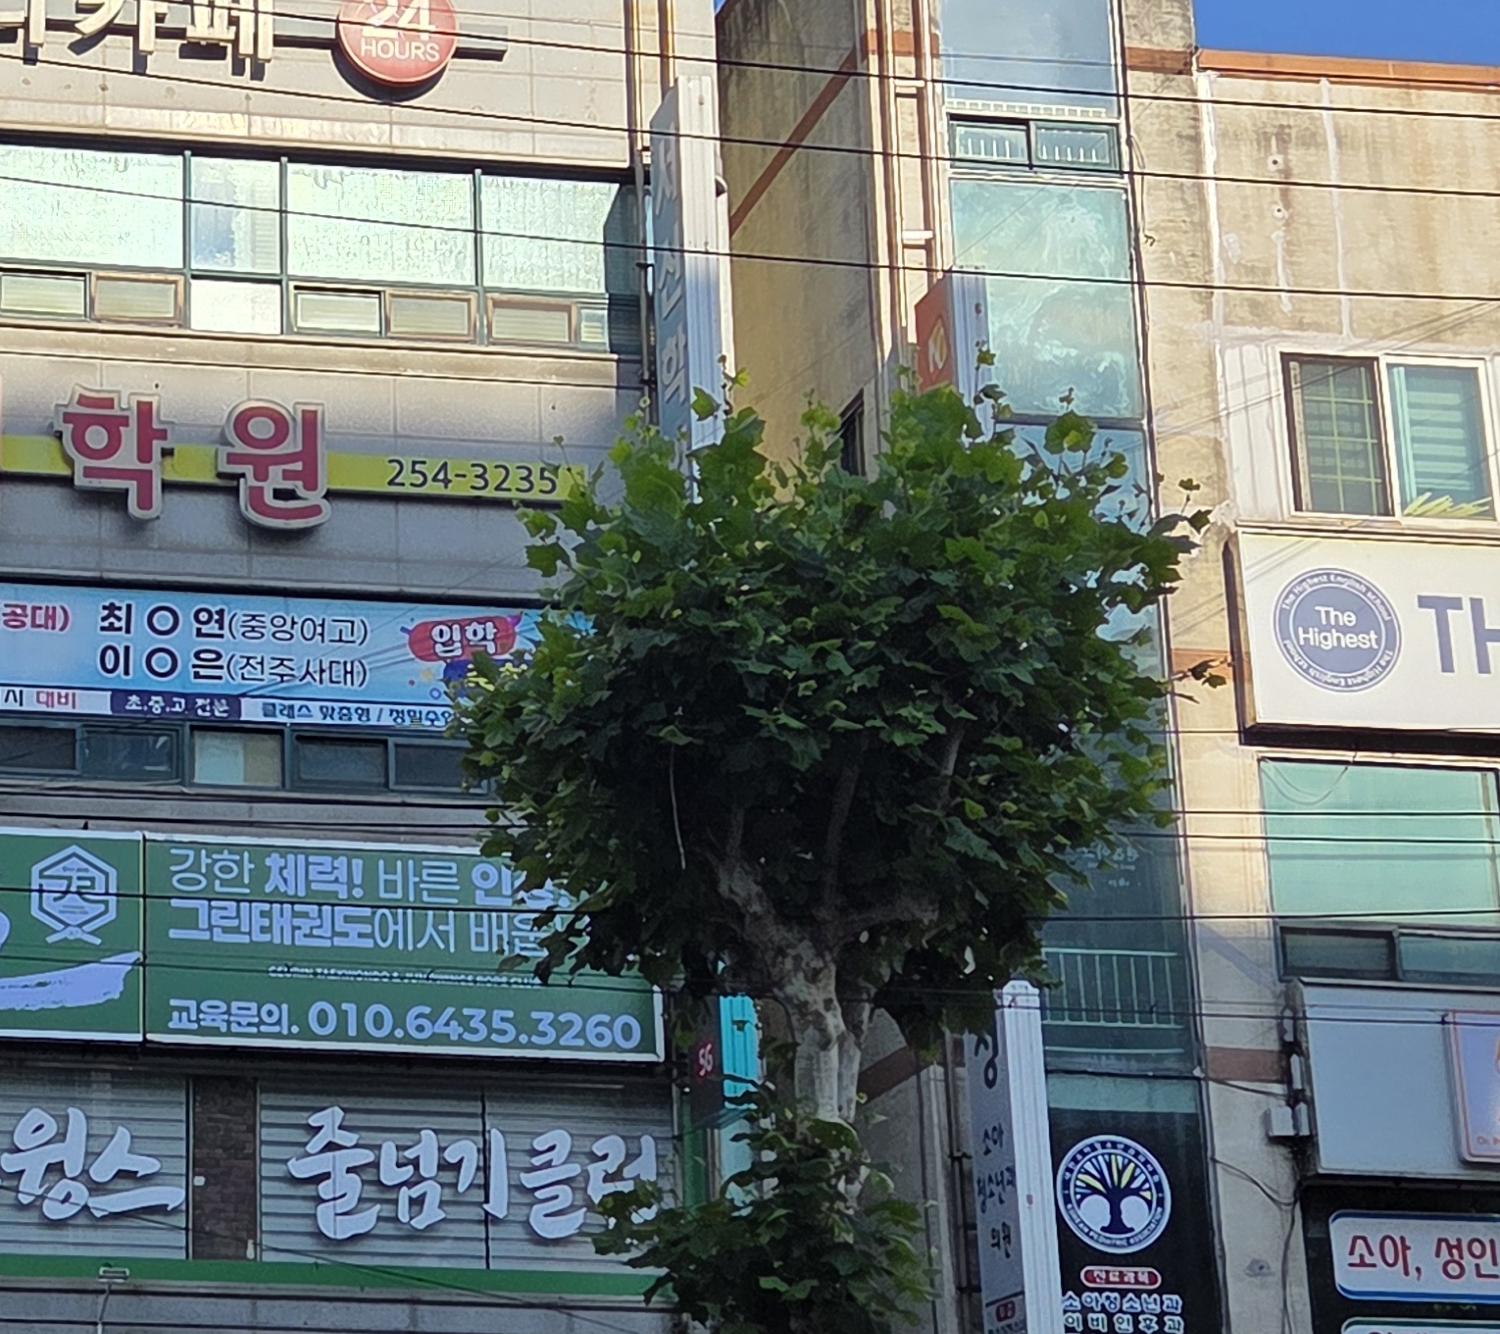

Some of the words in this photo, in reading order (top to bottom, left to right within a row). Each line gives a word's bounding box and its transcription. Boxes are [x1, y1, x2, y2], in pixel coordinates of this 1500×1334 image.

[361, 35, 441, 64] HOURS
[54, 383, 331, 528] 학원
[386, 458, 559, 496] 254-3235
[101, 601, 133, 635] 최
[1314, 605, 1357, 627] The
[430, 621, 498, 658] 입학
[1297, 626, 1379, 651] Highest
[100, 645, 132, 678] 이
[36, 689, 78, 710] 대비
[169, 848, 254, 895] 강한
[265, 853, 364, 898] 체력!
[379, 859, 461, 905] 바른
[168, 898, 456, 954] 그린태권도에서
[168, 999, 300, 1035] 교육문의.
[308, 1001, 642, 1050] 010.6435.3260
[1347, 1234, 1423, 1281] 소아,
[1063, 1290, 1183, 1314] 소아청소년과
[1064, 1312, 1185, 1334] 이비인후과
